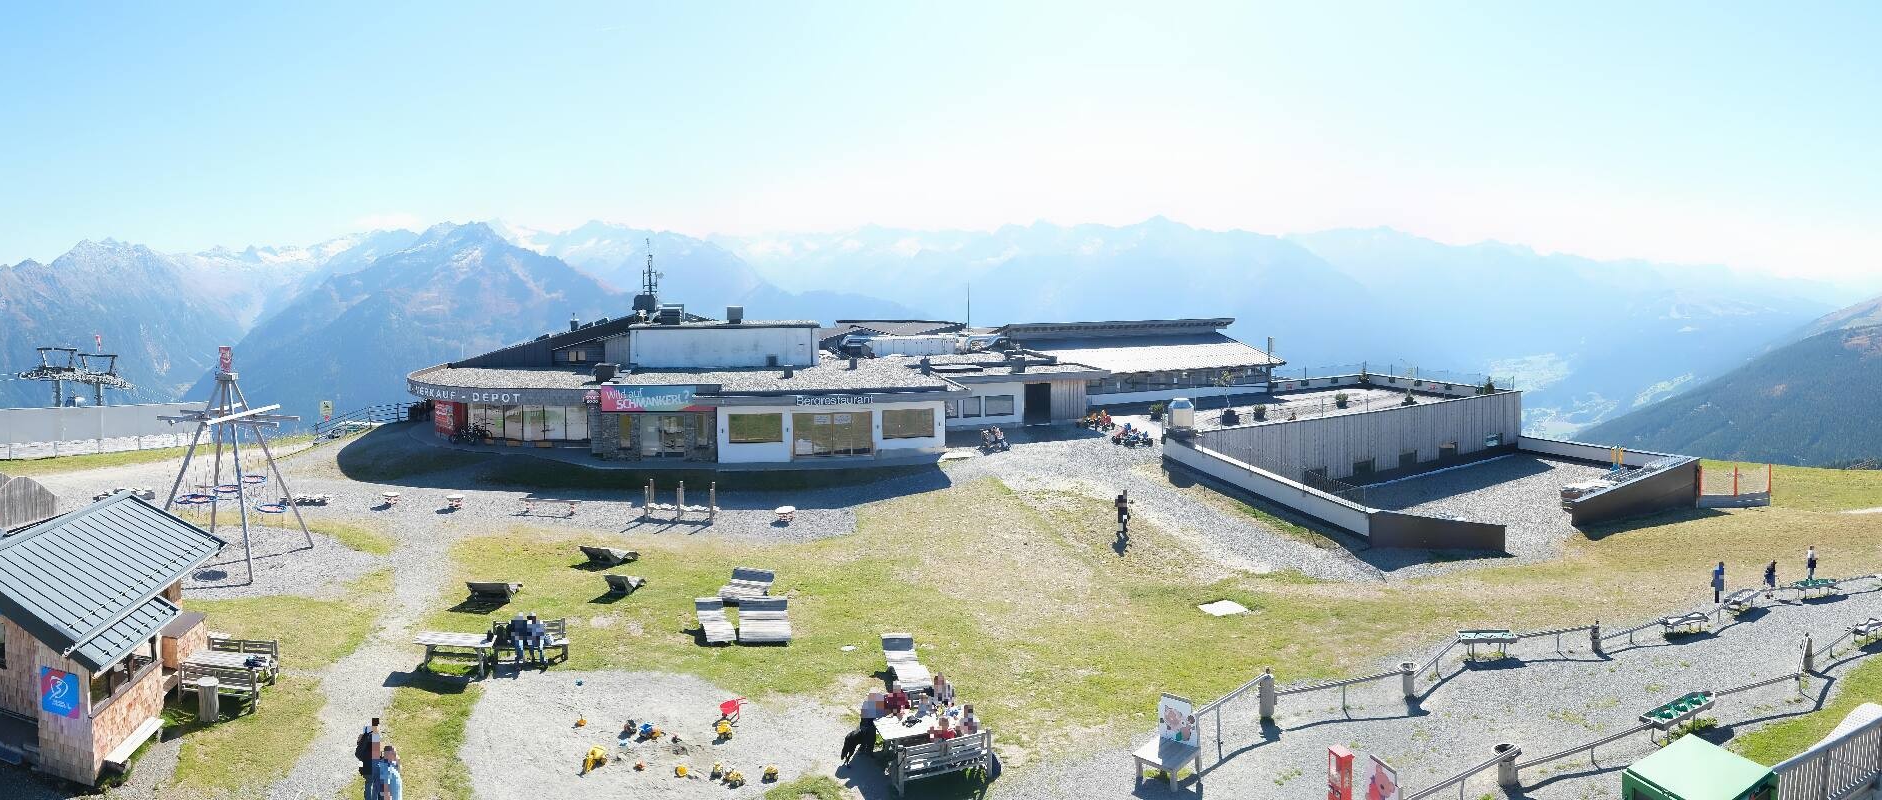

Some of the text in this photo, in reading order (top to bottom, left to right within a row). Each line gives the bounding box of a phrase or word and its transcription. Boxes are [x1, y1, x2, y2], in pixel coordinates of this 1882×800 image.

[415, 385, 456, 400] VERKAUF
[472, 392, 521, 403] DEPOT
[606, 387, 644, 400] Wild auf
[795, 394, 874, 406] Bergrestaurant
